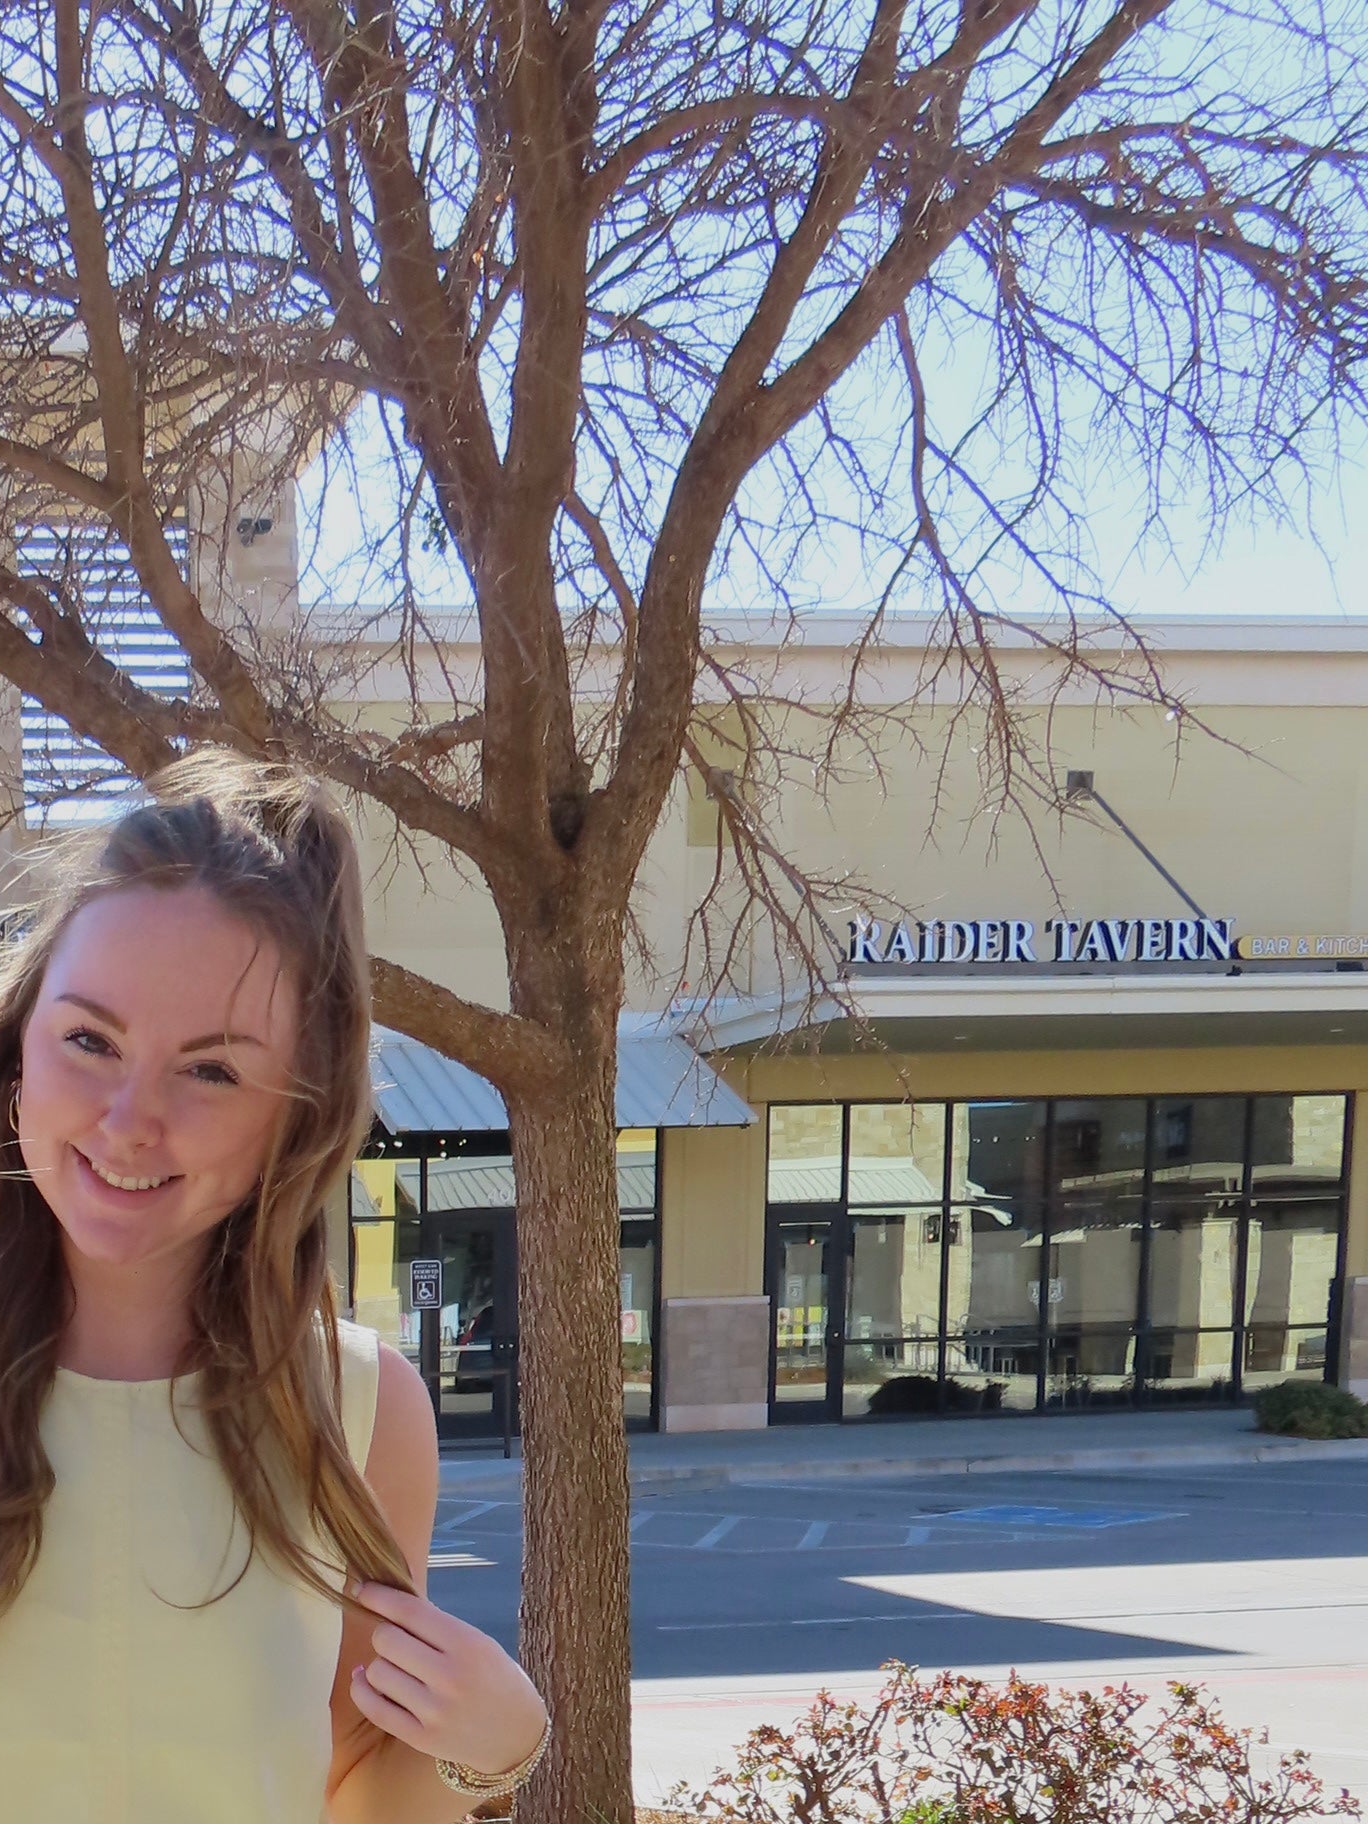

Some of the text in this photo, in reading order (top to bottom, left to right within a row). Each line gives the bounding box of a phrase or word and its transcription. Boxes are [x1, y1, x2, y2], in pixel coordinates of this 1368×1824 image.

[848, 917, 1236, 963] RAIDER TAVERN
[1252, 938, 1290, 956] BAR
[1296, 938, 1309, 955] &
